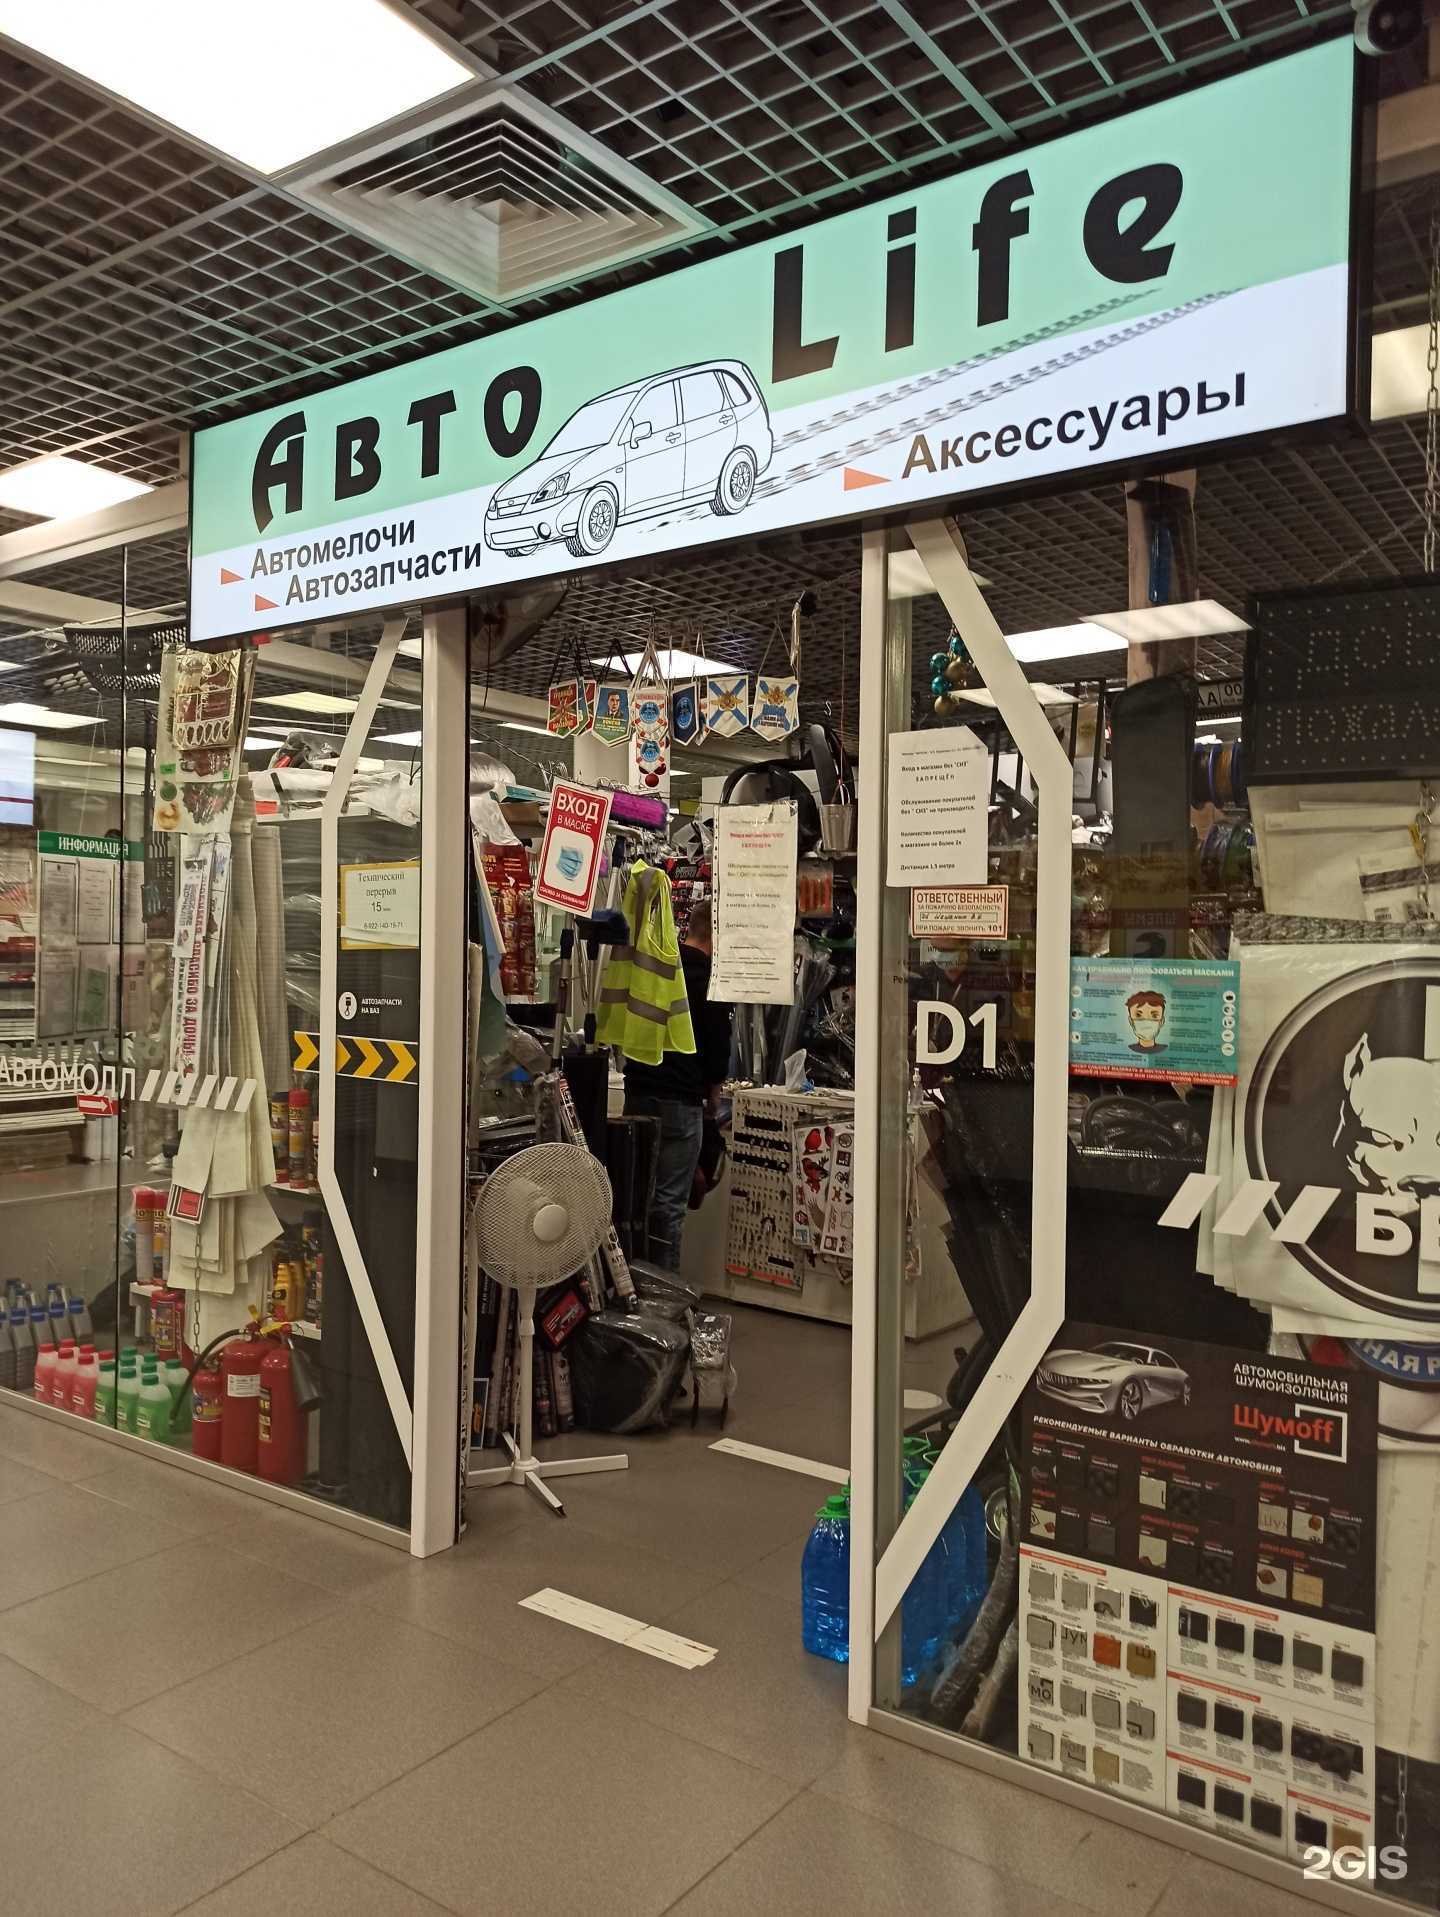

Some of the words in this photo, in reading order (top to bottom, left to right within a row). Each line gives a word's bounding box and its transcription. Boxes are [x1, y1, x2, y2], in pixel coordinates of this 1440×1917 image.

[251, 365, 542, 534] Авто
[772, 162, 1184, 383] Life
[901, 372, 1246, 479] Аксессуары
[250, 517, 416, 579] Автомелочи
[285, 542, 481, 605] Автозапчасти
[1276, 700, 1440, 746] ПОЖАЛ
[556, 792, 600, 824] ВХОД
[557, 815, 563, 824] В
[563, 816, 593, 834] МАСКЕ
[357, 871, 405, 883] Технический
[371, 901, 382, 912] 15
[916, 890, 1003, 903] ОТВЕТСТВЕННЫЙ
[361, 998, 403, 1007] АВТОЗАПЧАСТИ
[915, 999, 998, 1070] D1
[0, 1056, 136, 1101] АВТОМОЛЛ
[1233, 1362, 1348, 1393] АВТОМОБИЛЬНАЯ
[1235, 1374, 1348, 1404] ШУМОИЗОЛЯЦИЯ
[1033, 1415, 1108, 1438] РЕКОМЕНДУЕМЫЕ
[1109, 1431, 1158, 1448] ВАРИАНТЫ
[1160, 1442, 1215, 1461] ОБРАБОТКИ
[1216, 1452, 1282, 1475] АВТОМОБИЛЯ
